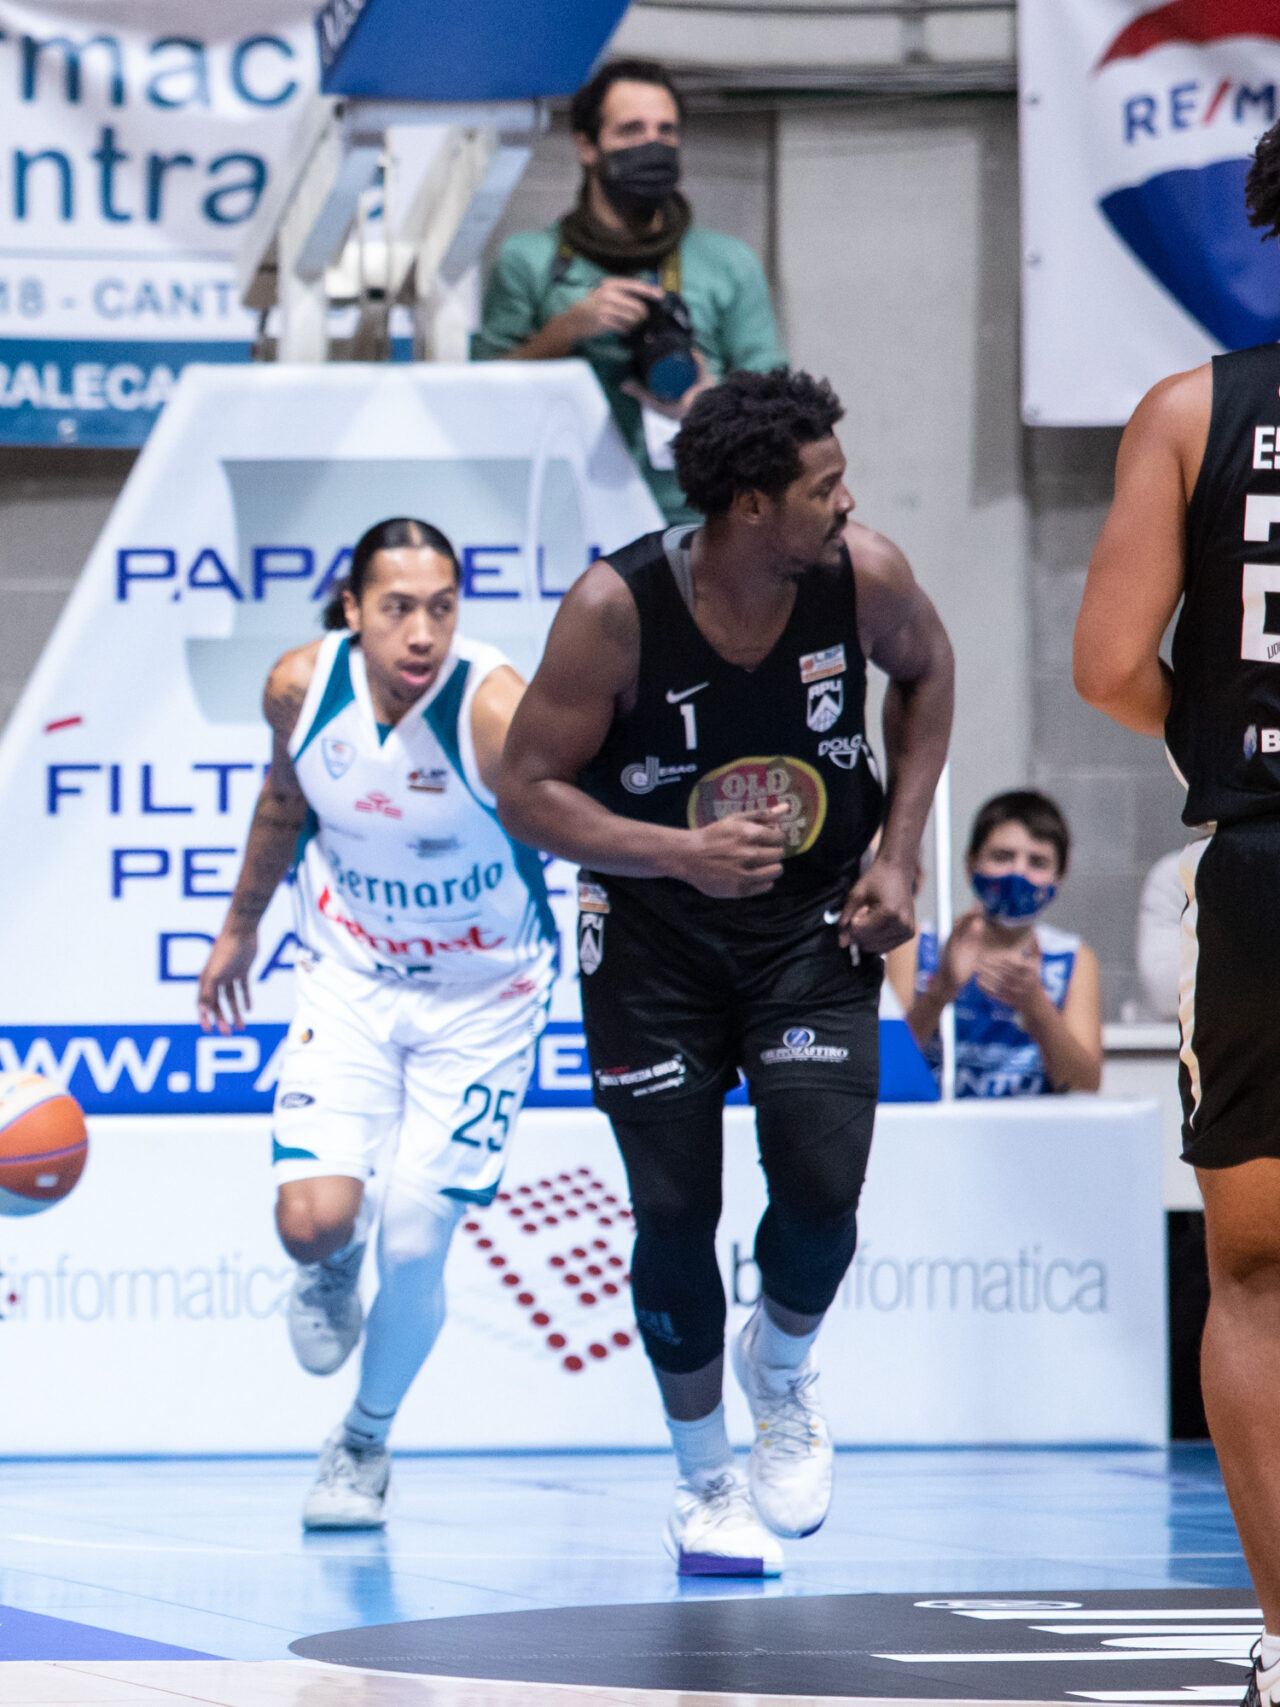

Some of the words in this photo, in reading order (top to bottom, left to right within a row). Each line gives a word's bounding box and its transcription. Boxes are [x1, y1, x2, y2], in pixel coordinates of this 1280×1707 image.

[93, 280, 258, 320] CANT
[680, 703, 698, 750] 1
[47, 763, 270, 816] FILT
[722, 769, 790, 799] OLD
[451, 1083, 516, 1152] 25
